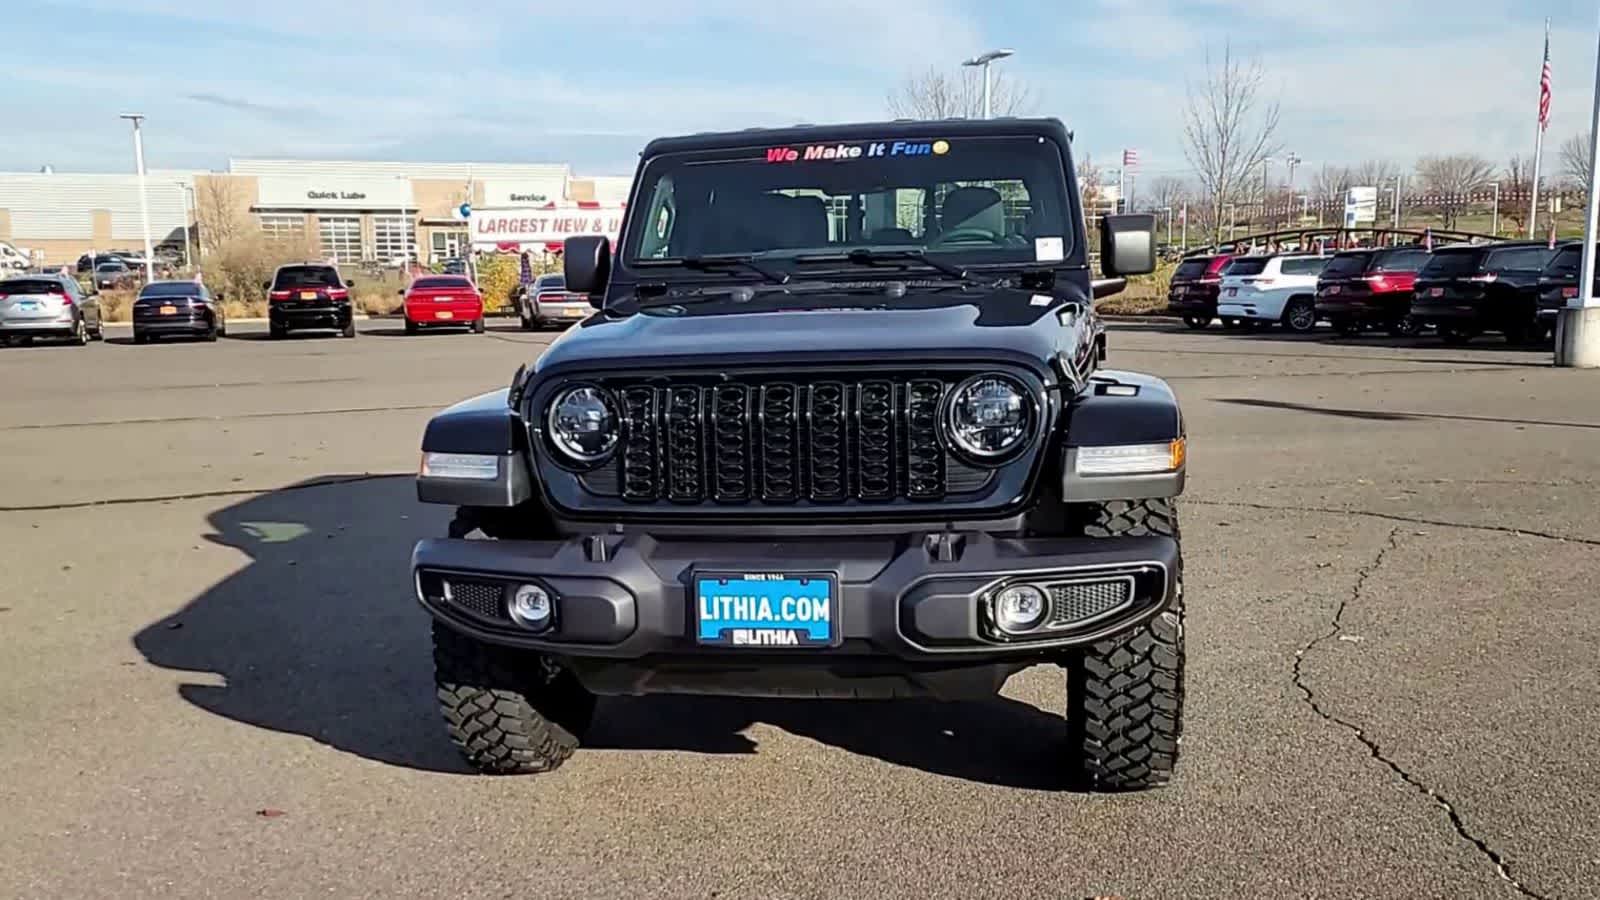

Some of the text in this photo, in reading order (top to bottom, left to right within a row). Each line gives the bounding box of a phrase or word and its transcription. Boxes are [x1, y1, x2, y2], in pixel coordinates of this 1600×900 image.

[767, 141, 930, 162] We Make It Fun
[307, 190, 366, 199] Quick Lube
[510, 193, 546, 201] Service
[478, 218, 548, 233] LARGEST
[552, 217, 587, 233] NEW
[592, 218, 602, 233] &
[700, 596, 829, 621] LITHIA.COM
[749, 629, 799, 645] LITHIA
